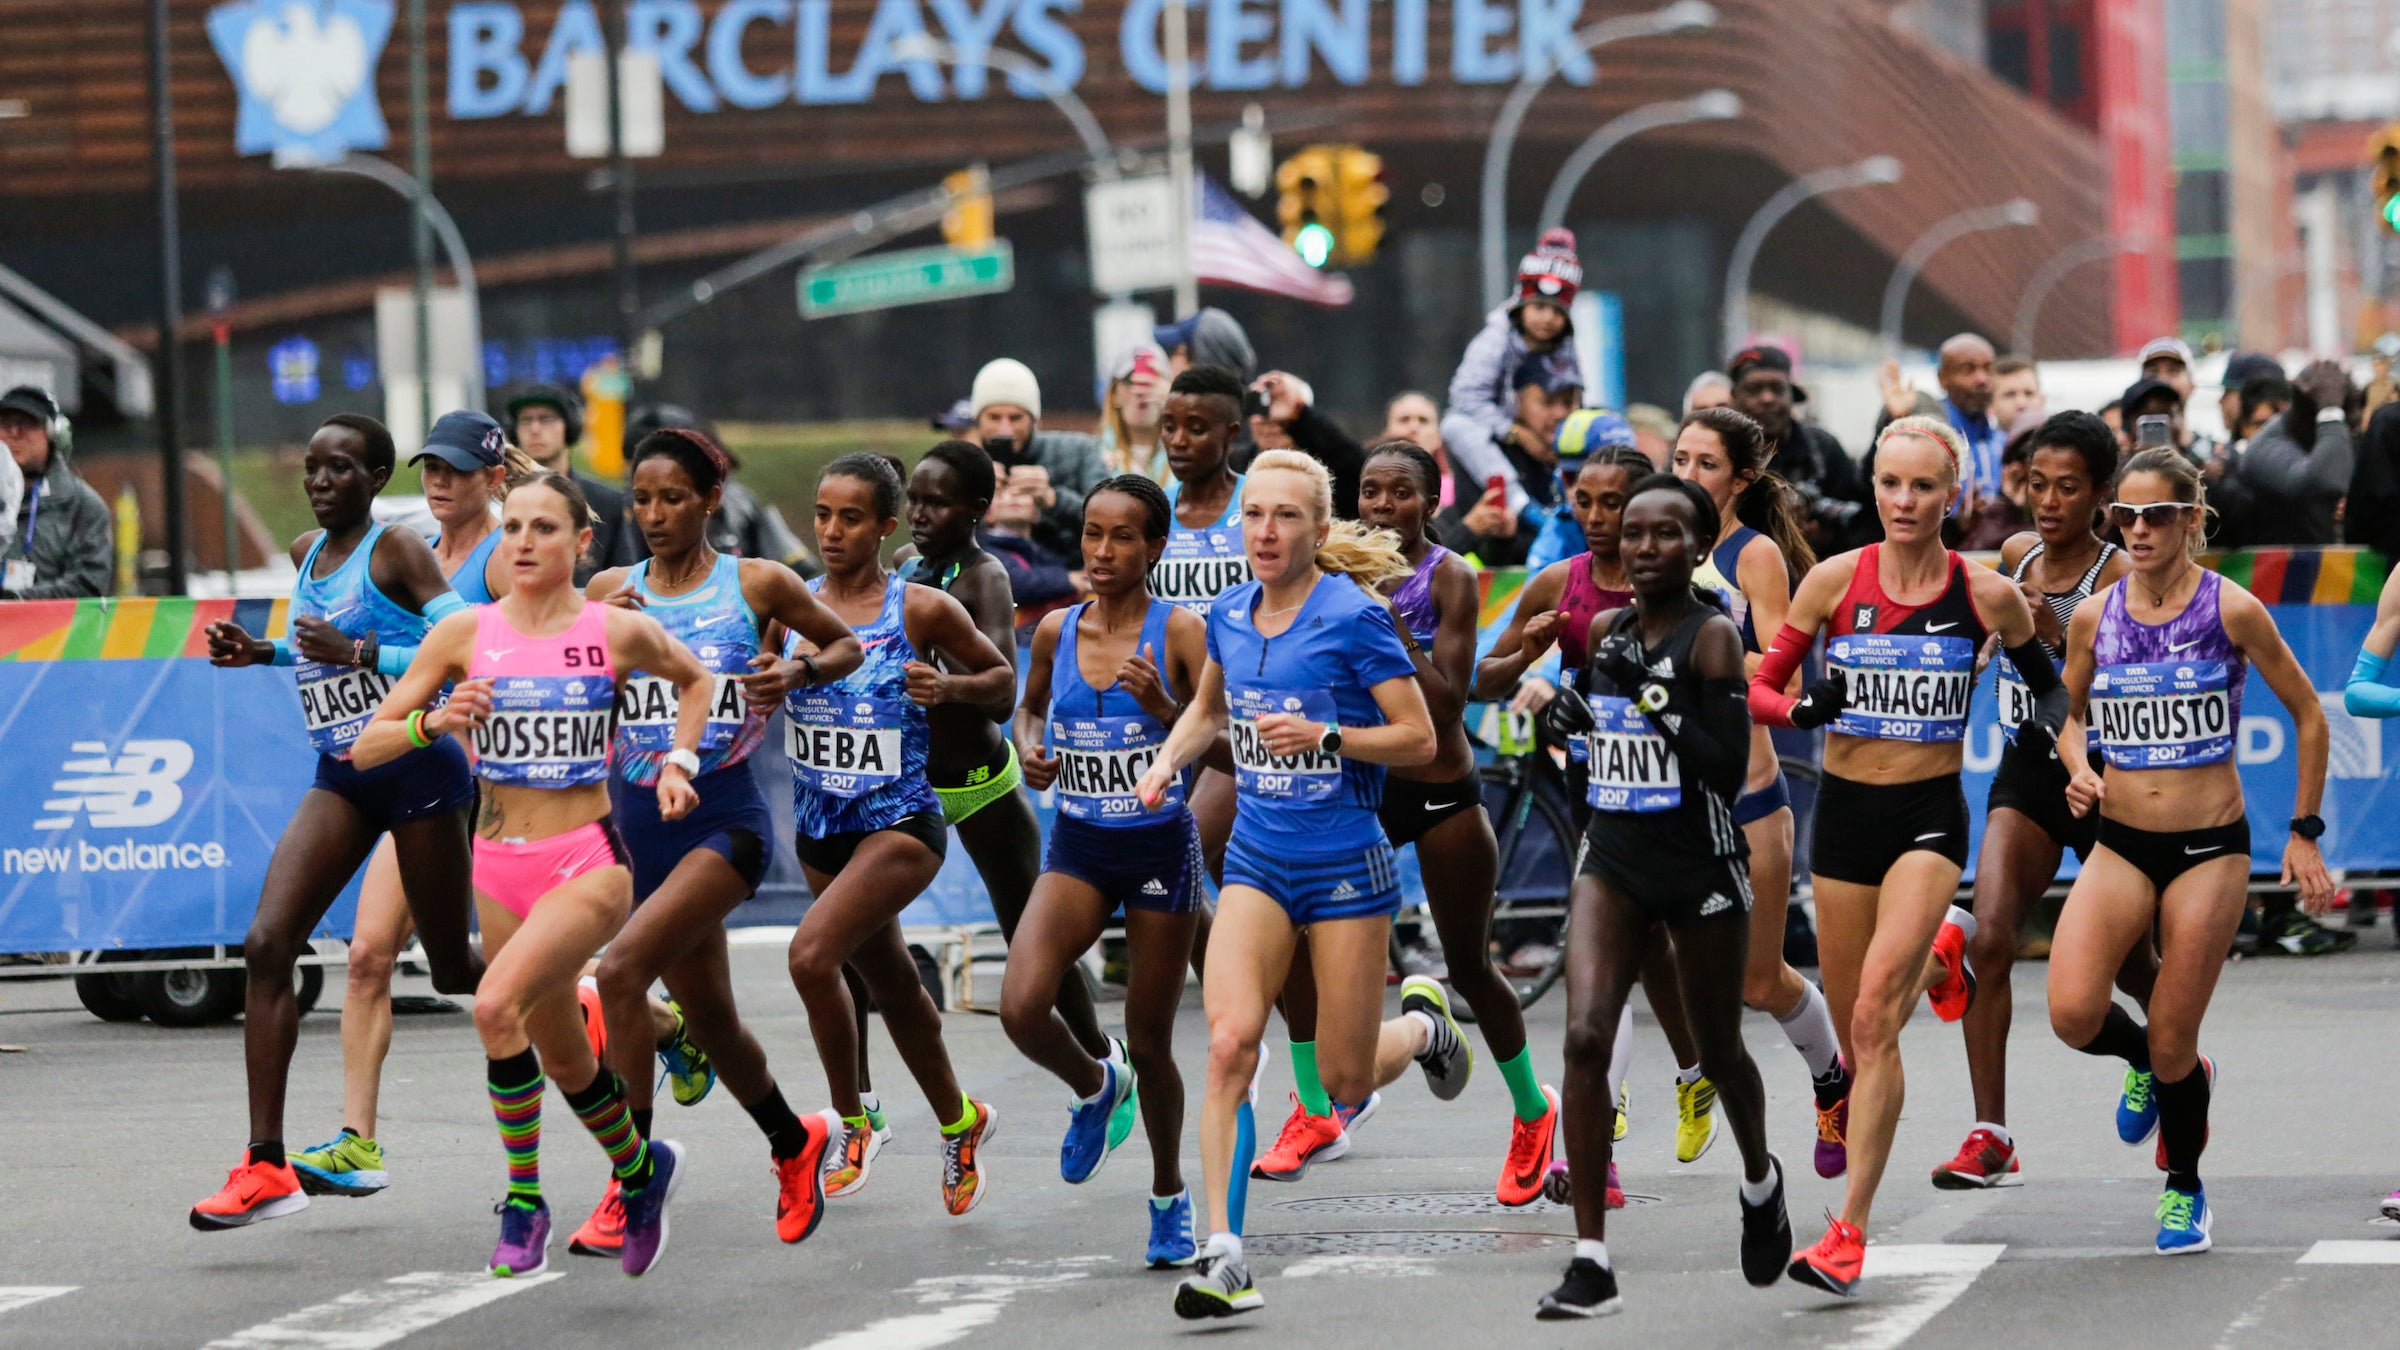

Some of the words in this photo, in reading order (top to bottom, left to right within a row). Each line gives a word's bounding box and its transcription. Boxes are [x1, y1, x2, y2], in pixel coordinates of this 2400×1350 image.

[446, 0, 1086, 119] BARCLAYS
[1866, 638, 1892, 647] TATA
[1851, 647, 1908, 657] CONSULTANCY
[1860, 656, 1898, 666] SERVICES
[1919, 656, 1945, 666] TATA
[2125, 667, 2148, 676] TATA
[508, 680, 535, 689] TATA
[2111, 676, 2163, 685] CONSULTANCY
[2173, 681, 2198, 689] TATA
[1829, 666, 1968, 717] ANAGAN
[2121, 684, 2155, 693] SERVICES
[502, 699, 541, 708] SERVICES
[563, 697, 589, 706] TATA
[794, 705, 843, 715] CONSULTANCY
[802, 714, 835, 723] SERVICES
[852, 716, 875, 724] TATA
[2102, 695, 2224, 741] AUGUSTO
[1075, 722, 1097, 730] TATA
[1623, 719, 1645, 729] TATA
[1880, 721, 1923, 737] 2017
[331, 720, 365, 741] 2017
[1066, 730, 1112, 739] CONSULTANCY
[475, 715, 605, 758] DOSSENA
[1122, 735, 1147, 745] TATA
[1074, 739, 1104, 747] SERVICES
[794, 726, 884, 771] DEBA
[2148, 746, 2187, 761] 2017
[1588, 737, 1672, 783] ITANY
[527, 764, 571, 780] 2017
[821, 773, 857, 789] 2017
[1257, 775, 1293, 791] 2017
[1598, 788, 1630, 805] 2017
[1101, 798, 1140, 813] 2017
[4, 847, 72, 875] new
[78, 837, 227, 873] balance
